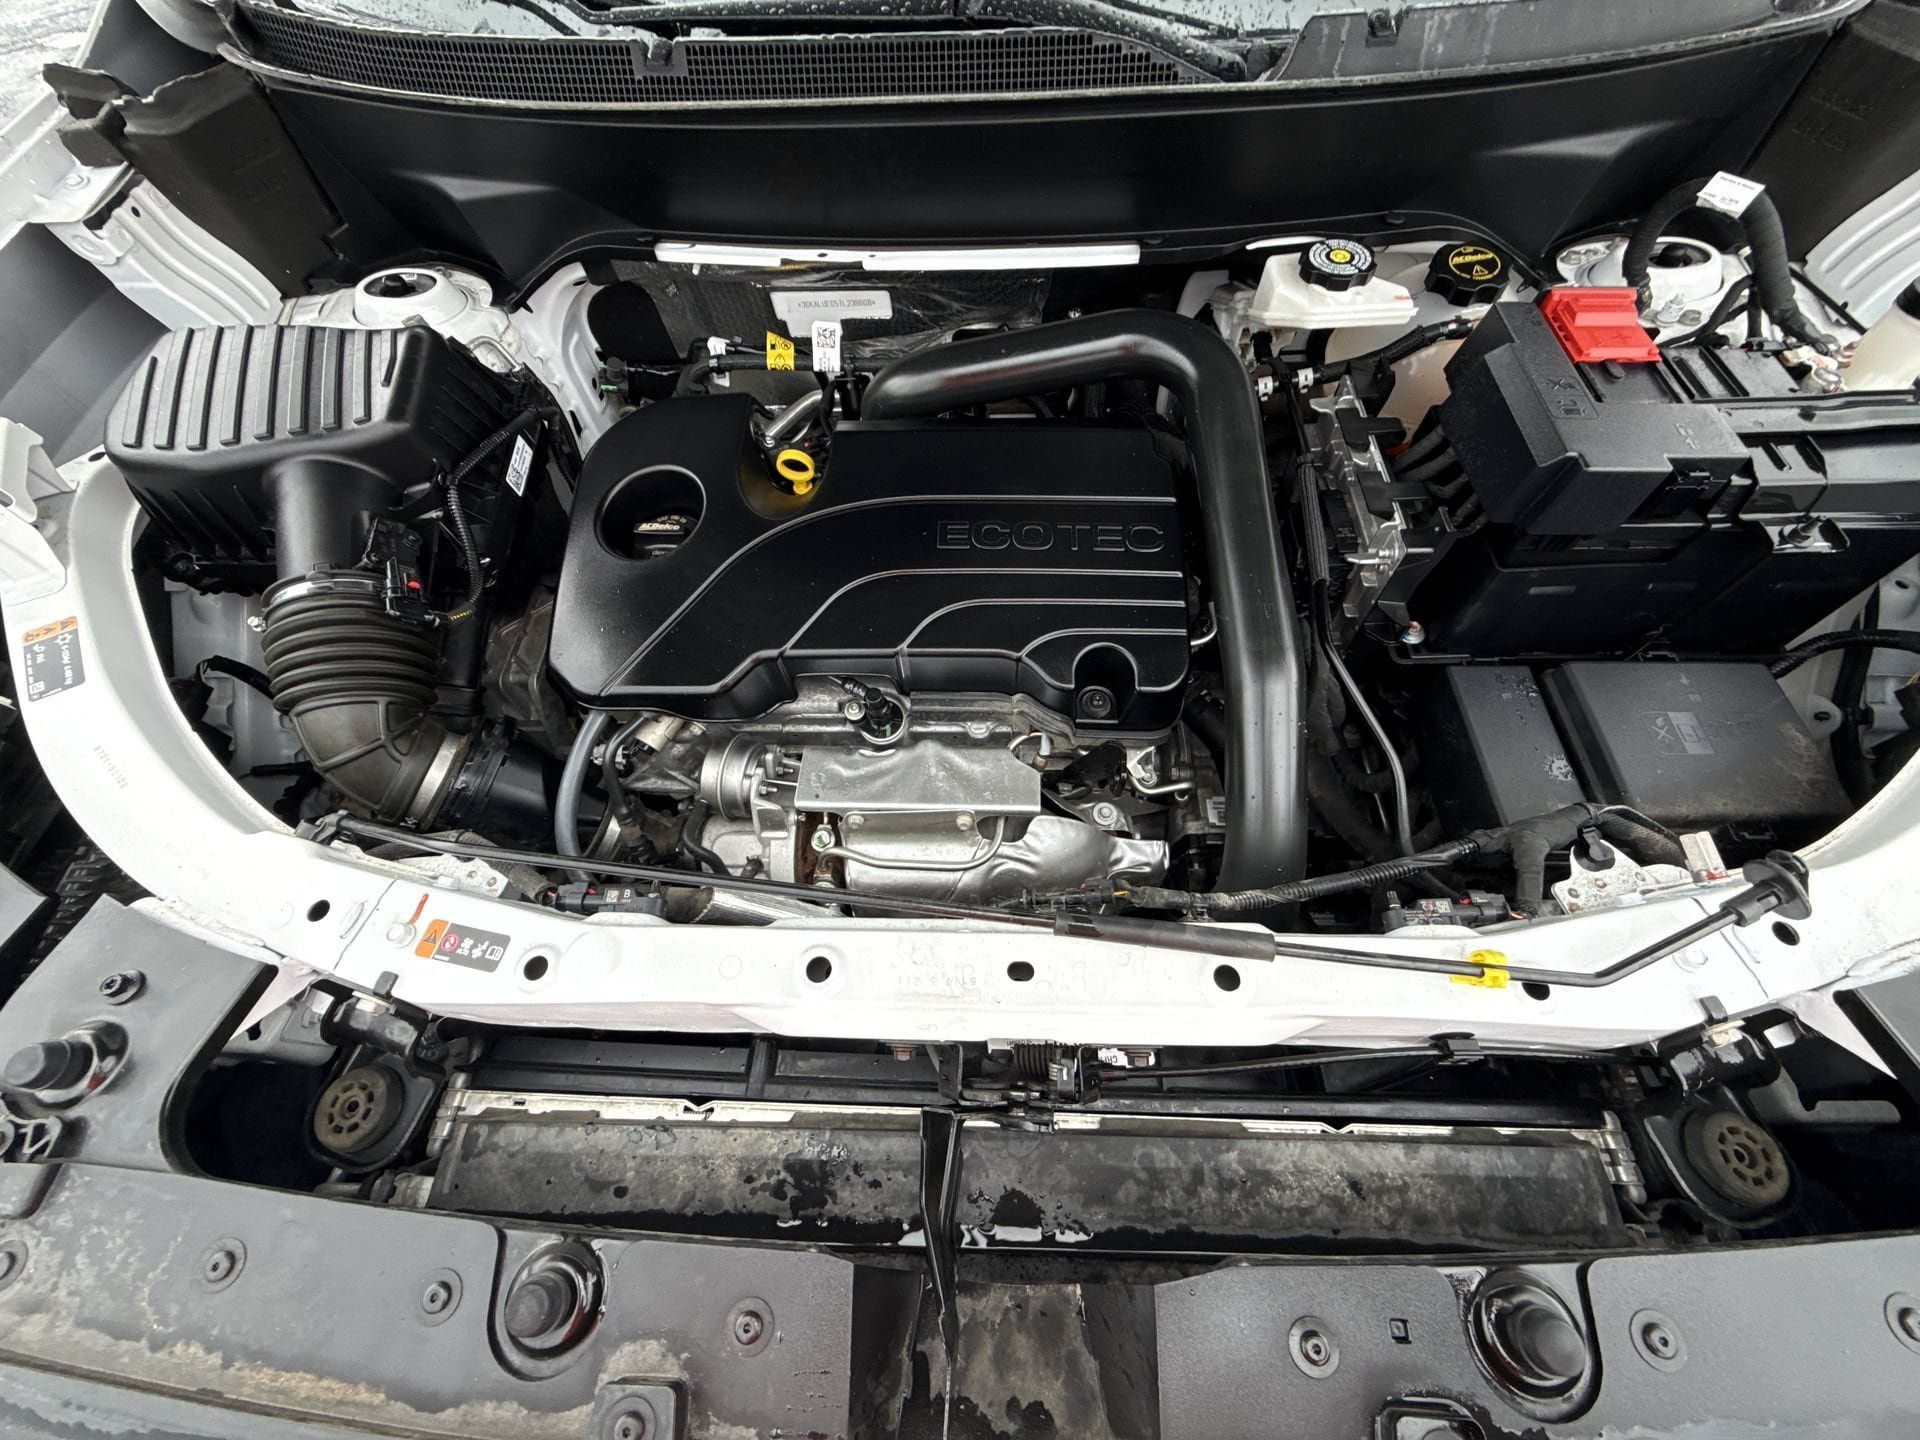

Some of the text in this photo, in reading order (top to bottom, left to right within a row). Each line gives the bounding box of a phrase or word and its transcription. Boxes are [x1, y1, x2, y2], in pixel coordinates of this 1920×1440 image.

[1451, 253, 1493, 265] ACDelco
[638, 522, 680, 531] ACDelco
[936, 520, 1165, 553] ECOTEC
[623, 889, 631, 898] B
